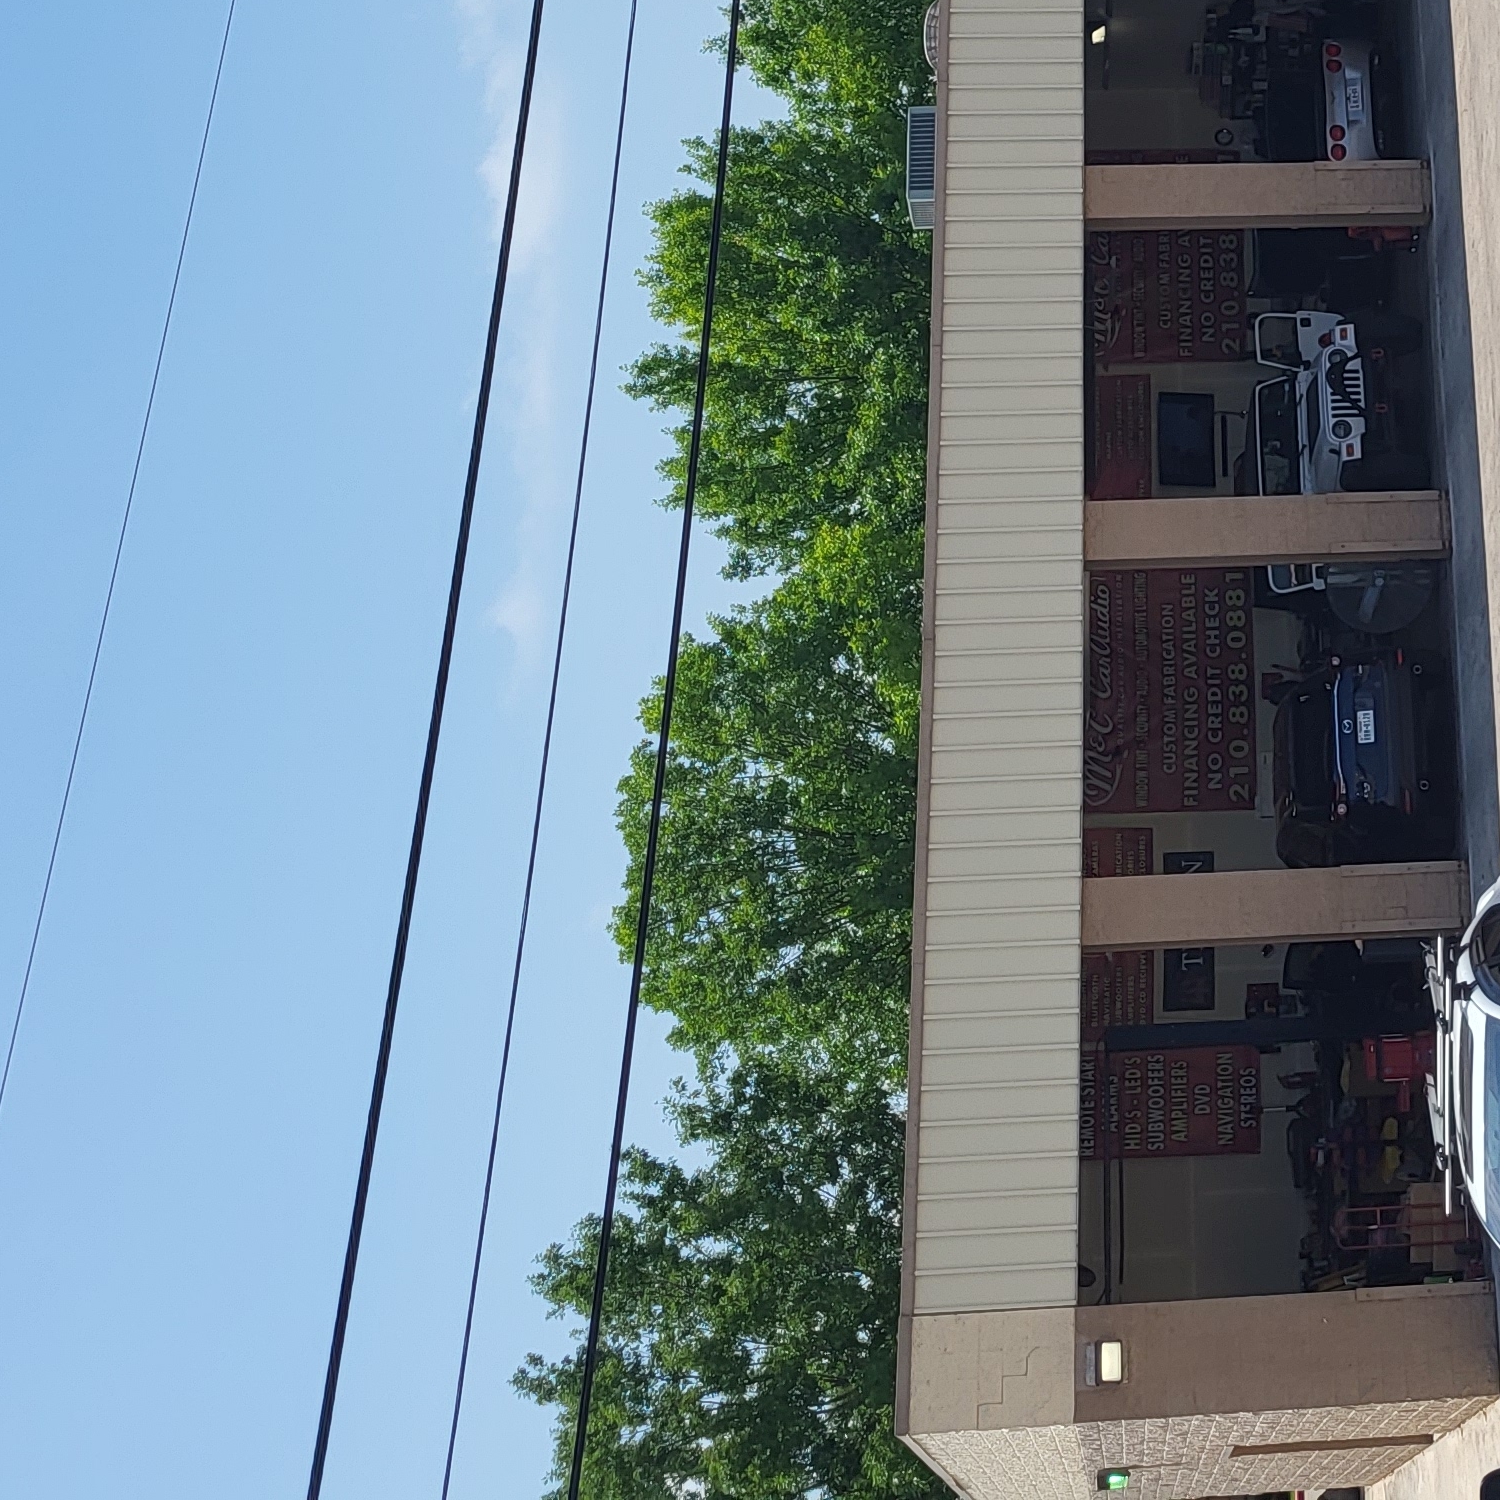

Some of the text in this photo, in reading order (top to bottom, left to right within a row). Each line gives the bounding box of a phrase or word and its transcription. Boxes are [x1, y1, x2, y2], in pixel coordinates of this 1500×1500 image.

[1158, 273, 1171, 328] CUSTOM
[1178, 254, 1193, 356] FINANCING
[1199, 236, 1215, 342] NO CREDIT
[1161, 604, 1177, 773] CUSTOM FABRICATION
[1180, 574, 1199, 806] FINANCING AVAILABLE
[1204, 588, 1222, 790] NO CREDIT CHECK
[1225, 572, 1249, 802] 210.838.0881
[1080, 1056, 1095, 1156] REMOTE START
[1101, 1076, 1118, 1131] ALARMS
[1123, 1057, 1141, 1094] LED'S
[1147, 1055, 1165, 1150] SUBWOOFERS
[1170, 1061, 1188, 1142] AMPLIFIERS
[1194, 1084, 1211, 1115] DVD
[1217, 1053, 1234, 1145] NAVIGATION
[1240, 1068, 1257, 1128] STEREOS
[1124, 1110, 1142, 1150] HID'S
